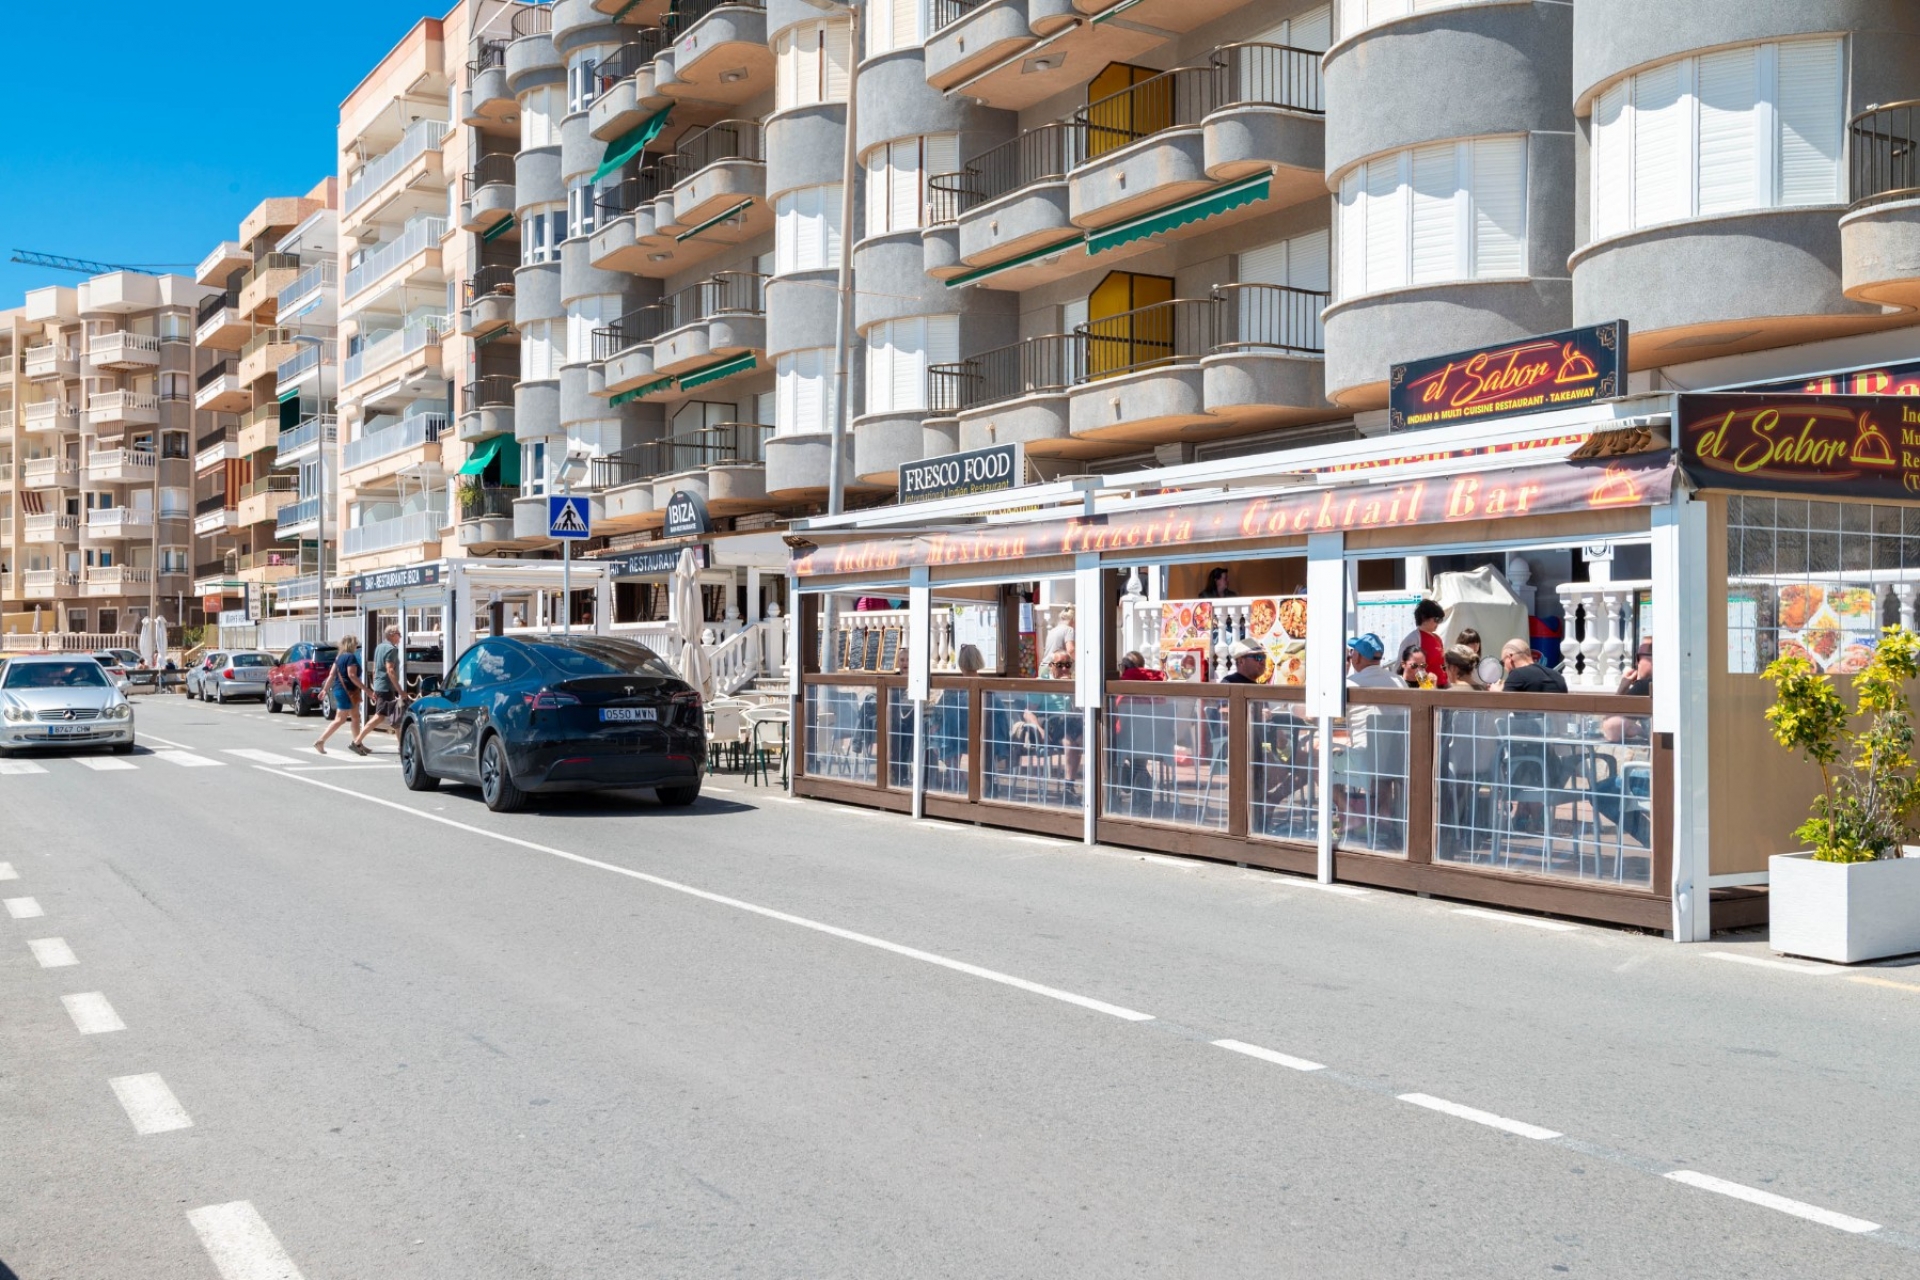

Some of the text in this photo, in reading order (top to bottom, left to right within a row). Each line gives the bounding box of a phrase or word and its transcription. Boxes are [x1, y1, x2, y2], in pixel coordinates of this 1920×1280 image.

[1422, 352, 1550, 407] el Sabor
[1406, 386, 1596, 425] INDIAN & MULTI CUISINE RESTAURANT TAKEAWAY
[1696, 408, 1848, 473] el Sabor
[905, 452, 1011, 492] FRESCO FOOD
[904, 478, 1010, 504] International Indian Restaurant
[668, 502, 696, 525] IBIZA
[834, 477, 1539, 572] Indian Mexican Pizzeria Cocktail Bar
[407, 569, 420, 586] IBIZA
[629, 551, 681, 573] RESTAURANT
[606, 709, 631, 719] 0550
